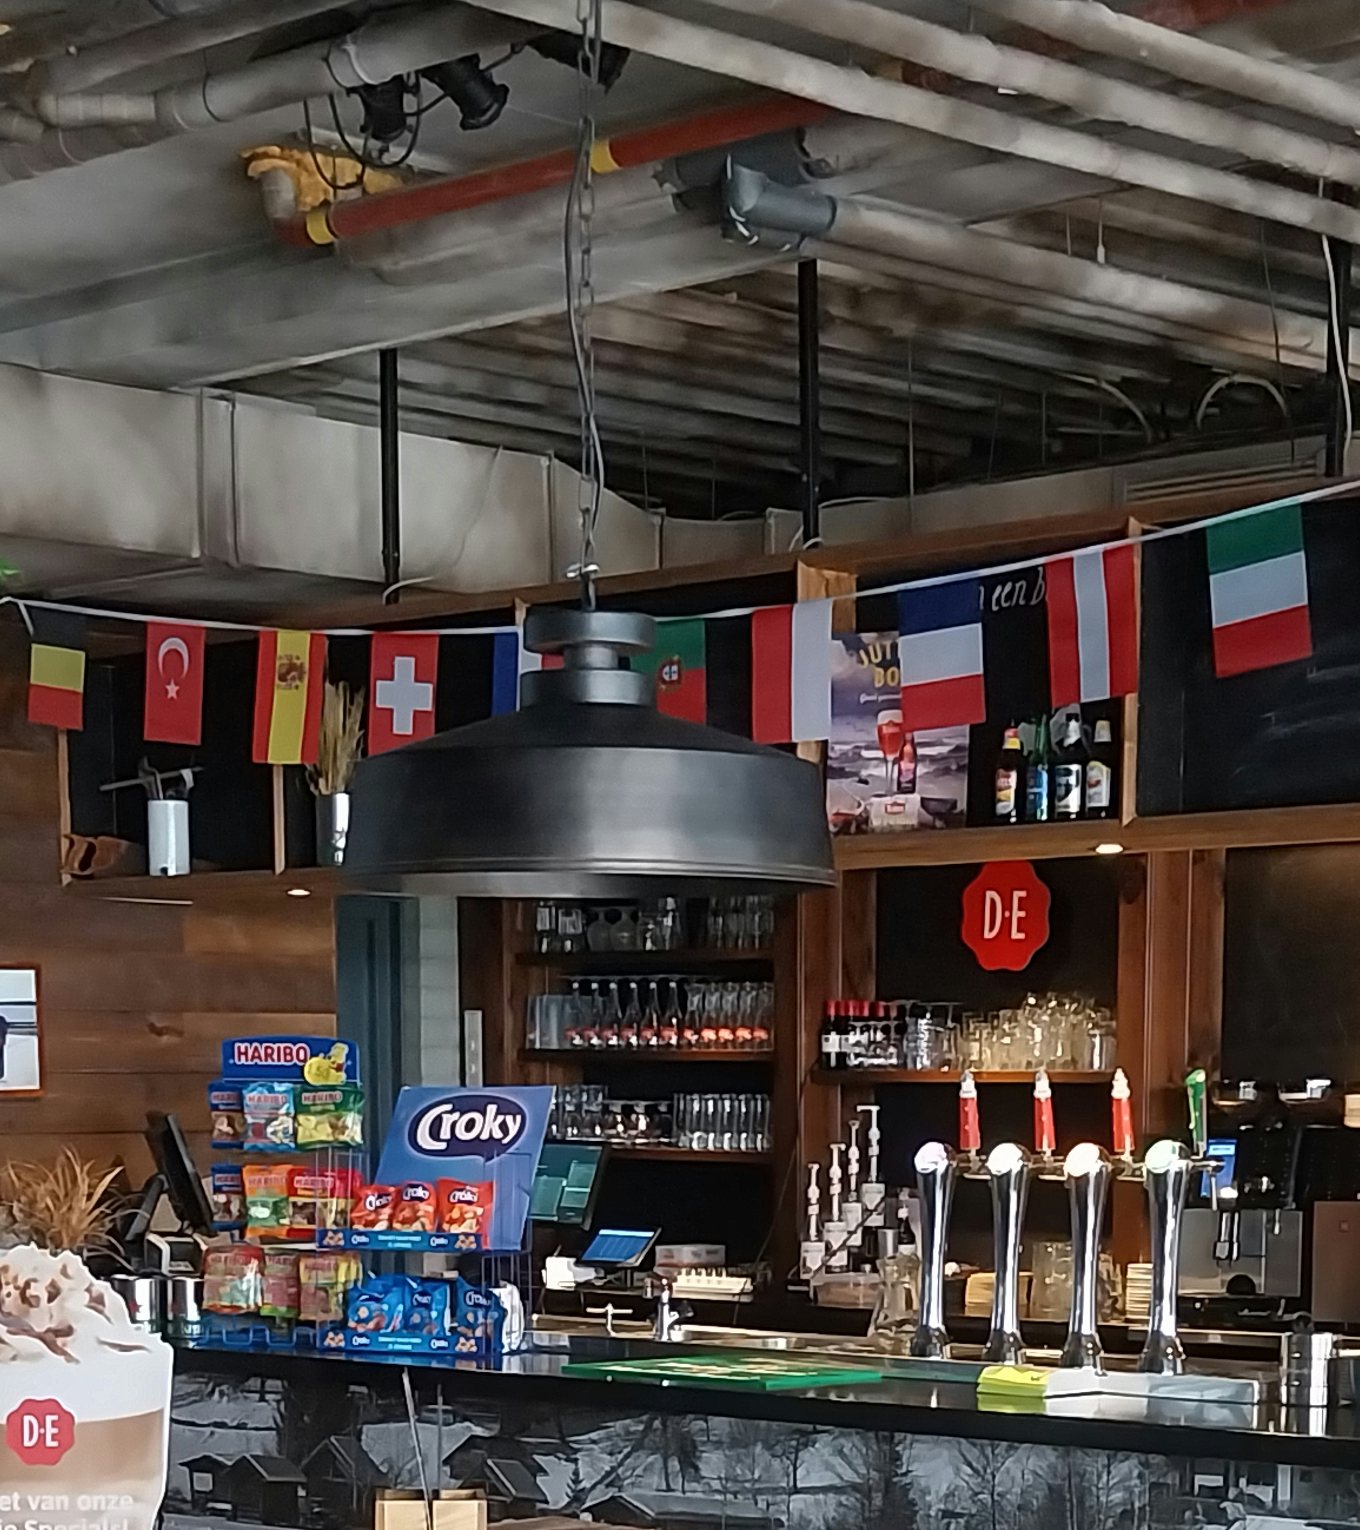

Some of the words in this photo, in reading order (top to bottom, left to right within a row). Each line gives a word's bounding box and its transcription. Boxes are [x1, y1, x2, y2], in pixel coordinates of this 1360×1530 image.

[991, 579, 1027, 612] een
[859, 641, 892, 668] JUT
[873, 666, 900, 688] BO
[234, 1042, 311, 1066] HARIBO
[415, 1103, 522, 1151] Croky
[27, 1495, 70, 1512] van
[76, 1494, 135, 1511] onze
